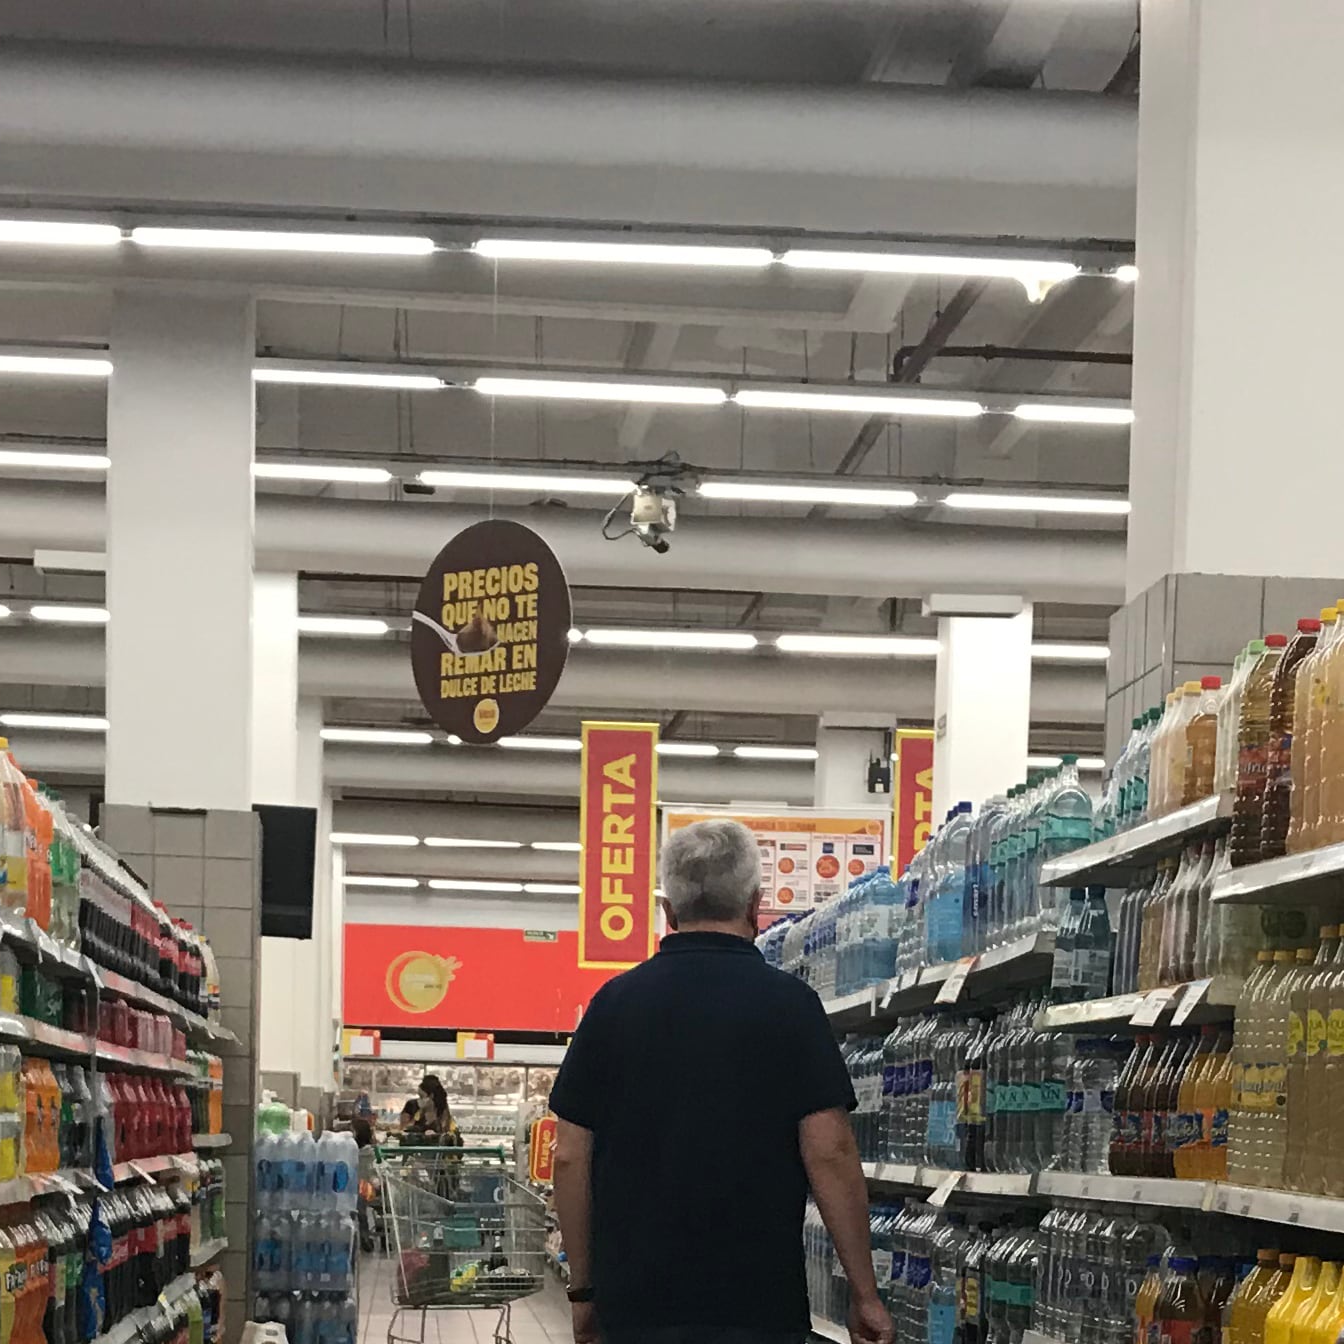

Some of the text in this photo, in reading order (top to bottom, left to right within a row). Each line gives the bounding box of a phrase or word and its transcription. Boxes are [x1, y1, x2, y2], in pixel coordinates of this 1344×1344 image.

[443, 562, 539, 601] PRECIOS
[442, 594, 538, 630] QUE NO TE
[497, 620, 538, 643] HACEN
[441, 643, 537, 677] REMAR EN
[441, 671, 537, 698] DULCE DE LECHE
[602, 754, 637, 942] OFERTA
